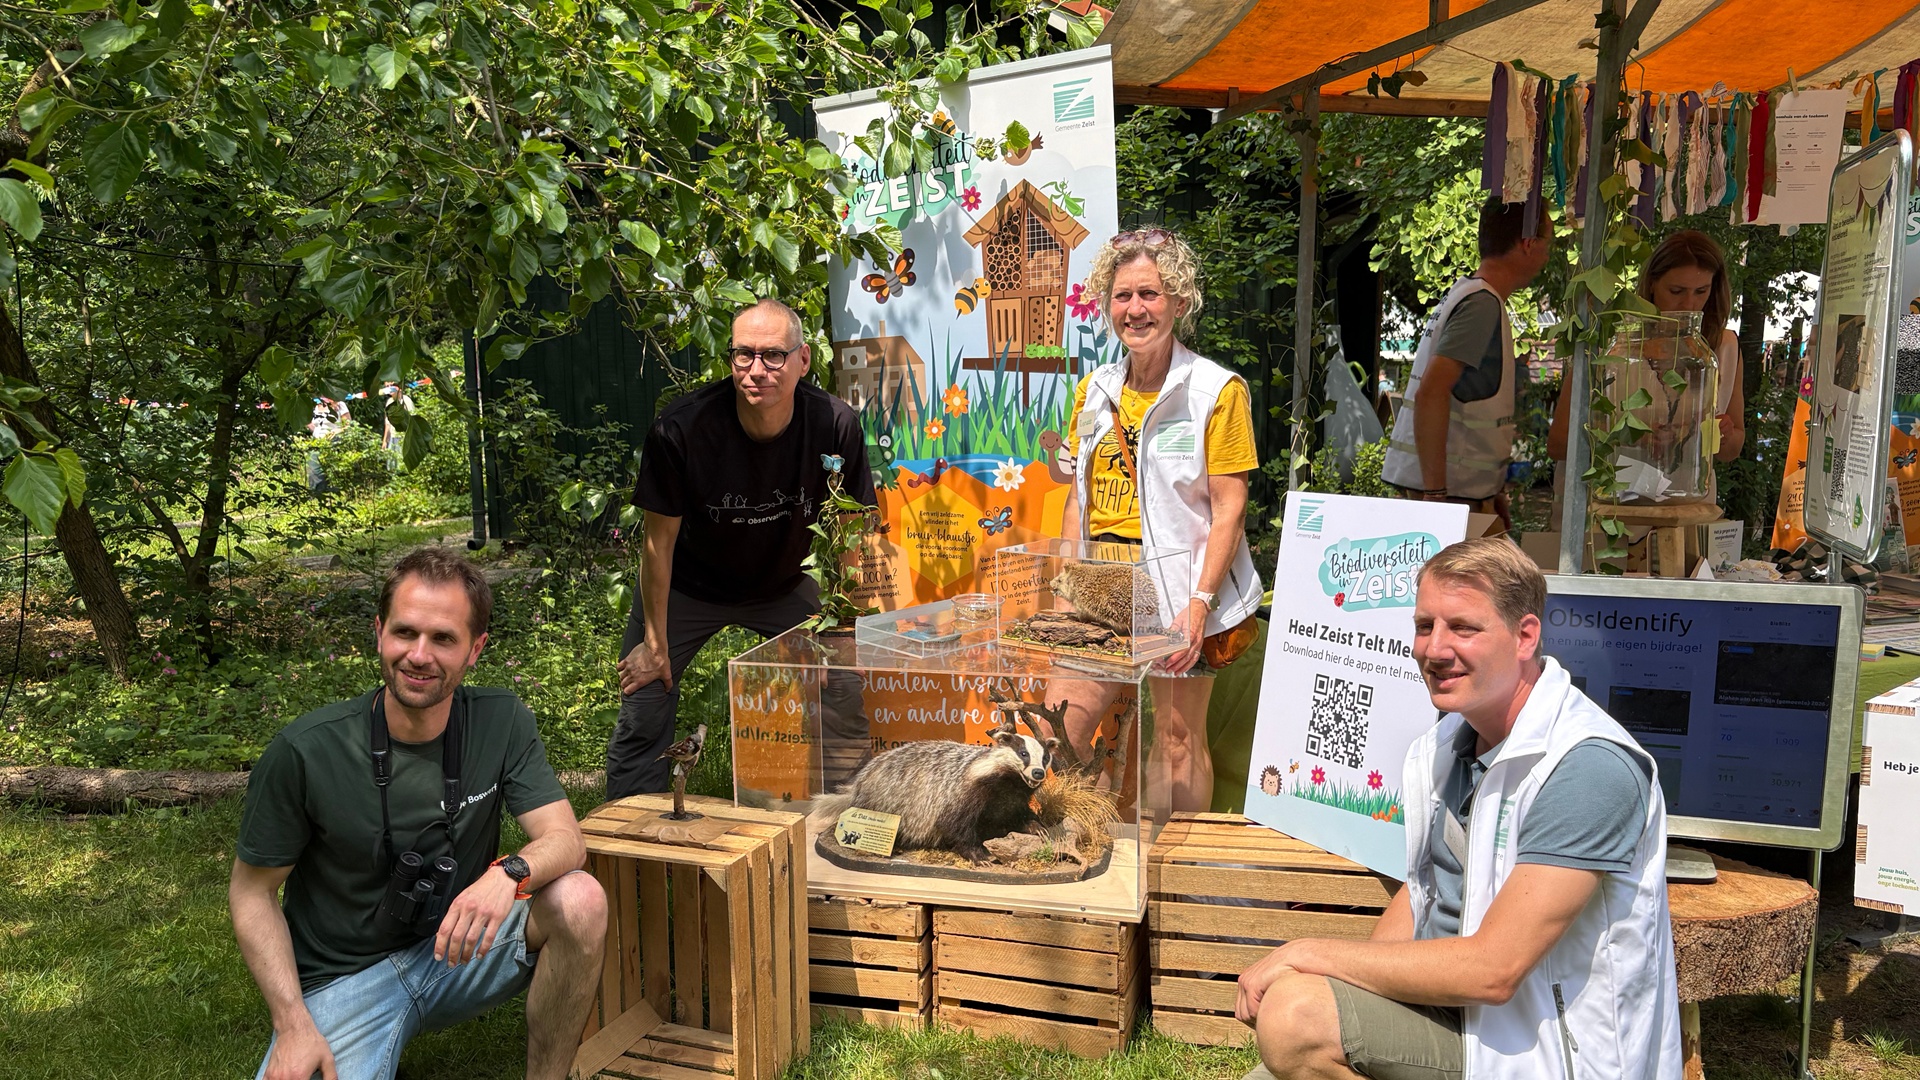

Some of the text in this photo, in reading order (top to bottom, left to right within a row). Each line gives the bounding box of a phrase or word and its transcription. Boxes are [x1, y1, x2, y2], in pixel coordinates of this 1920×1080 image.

[1055, 120, 1095, 132] Gemeente Zeist
[864, 160, 971, 217] ZEIST
[1094, 476, 1139, 515] HAPP
[1002, 560, 1016, 568] bijen
[1330, 536, 1431, 579] Biodiversiteit
[862, 584, 880, 592] bermen
[1012, 573, 1050, 591] soorten
[1339, 562, 1418, 604] in Zeist
[853, 590, 902, 600] kruidenrijk mengsel.
[1022, 586, 1051, 598] gemeente
[1548, 608, 1693, 638] ObsIdentify
[1288, 618, 1416, 660] Heel Zeist Telt Me
[1558, 638, 1572, 647] en
[1574, 638, 1598, 648] naar
[1601, 639, 1612, 649] je
[1615, 640, 1647, 650] eigen
[1650, 640, 1702, 654] bijdrage!
[1283, 641, 1424, 684] Download hier de app en tel mee
[951, 672, 1049, 694] insecen
[874, 706, 902, 725] en
[907, 697, 985, 726] andere
[1720, 733, 1732, 742] 70
[1883, 761, 1920, 775] Heb je
[1718, 774, 1734, 782] 111
[468, 783, 498, 804] Boswerf
[1878, 866, 1910, 876] Jouw huis,
[1878, 872, 1916, 885] jouw energie,
[1892, 881, 1919, 892] toekomst
